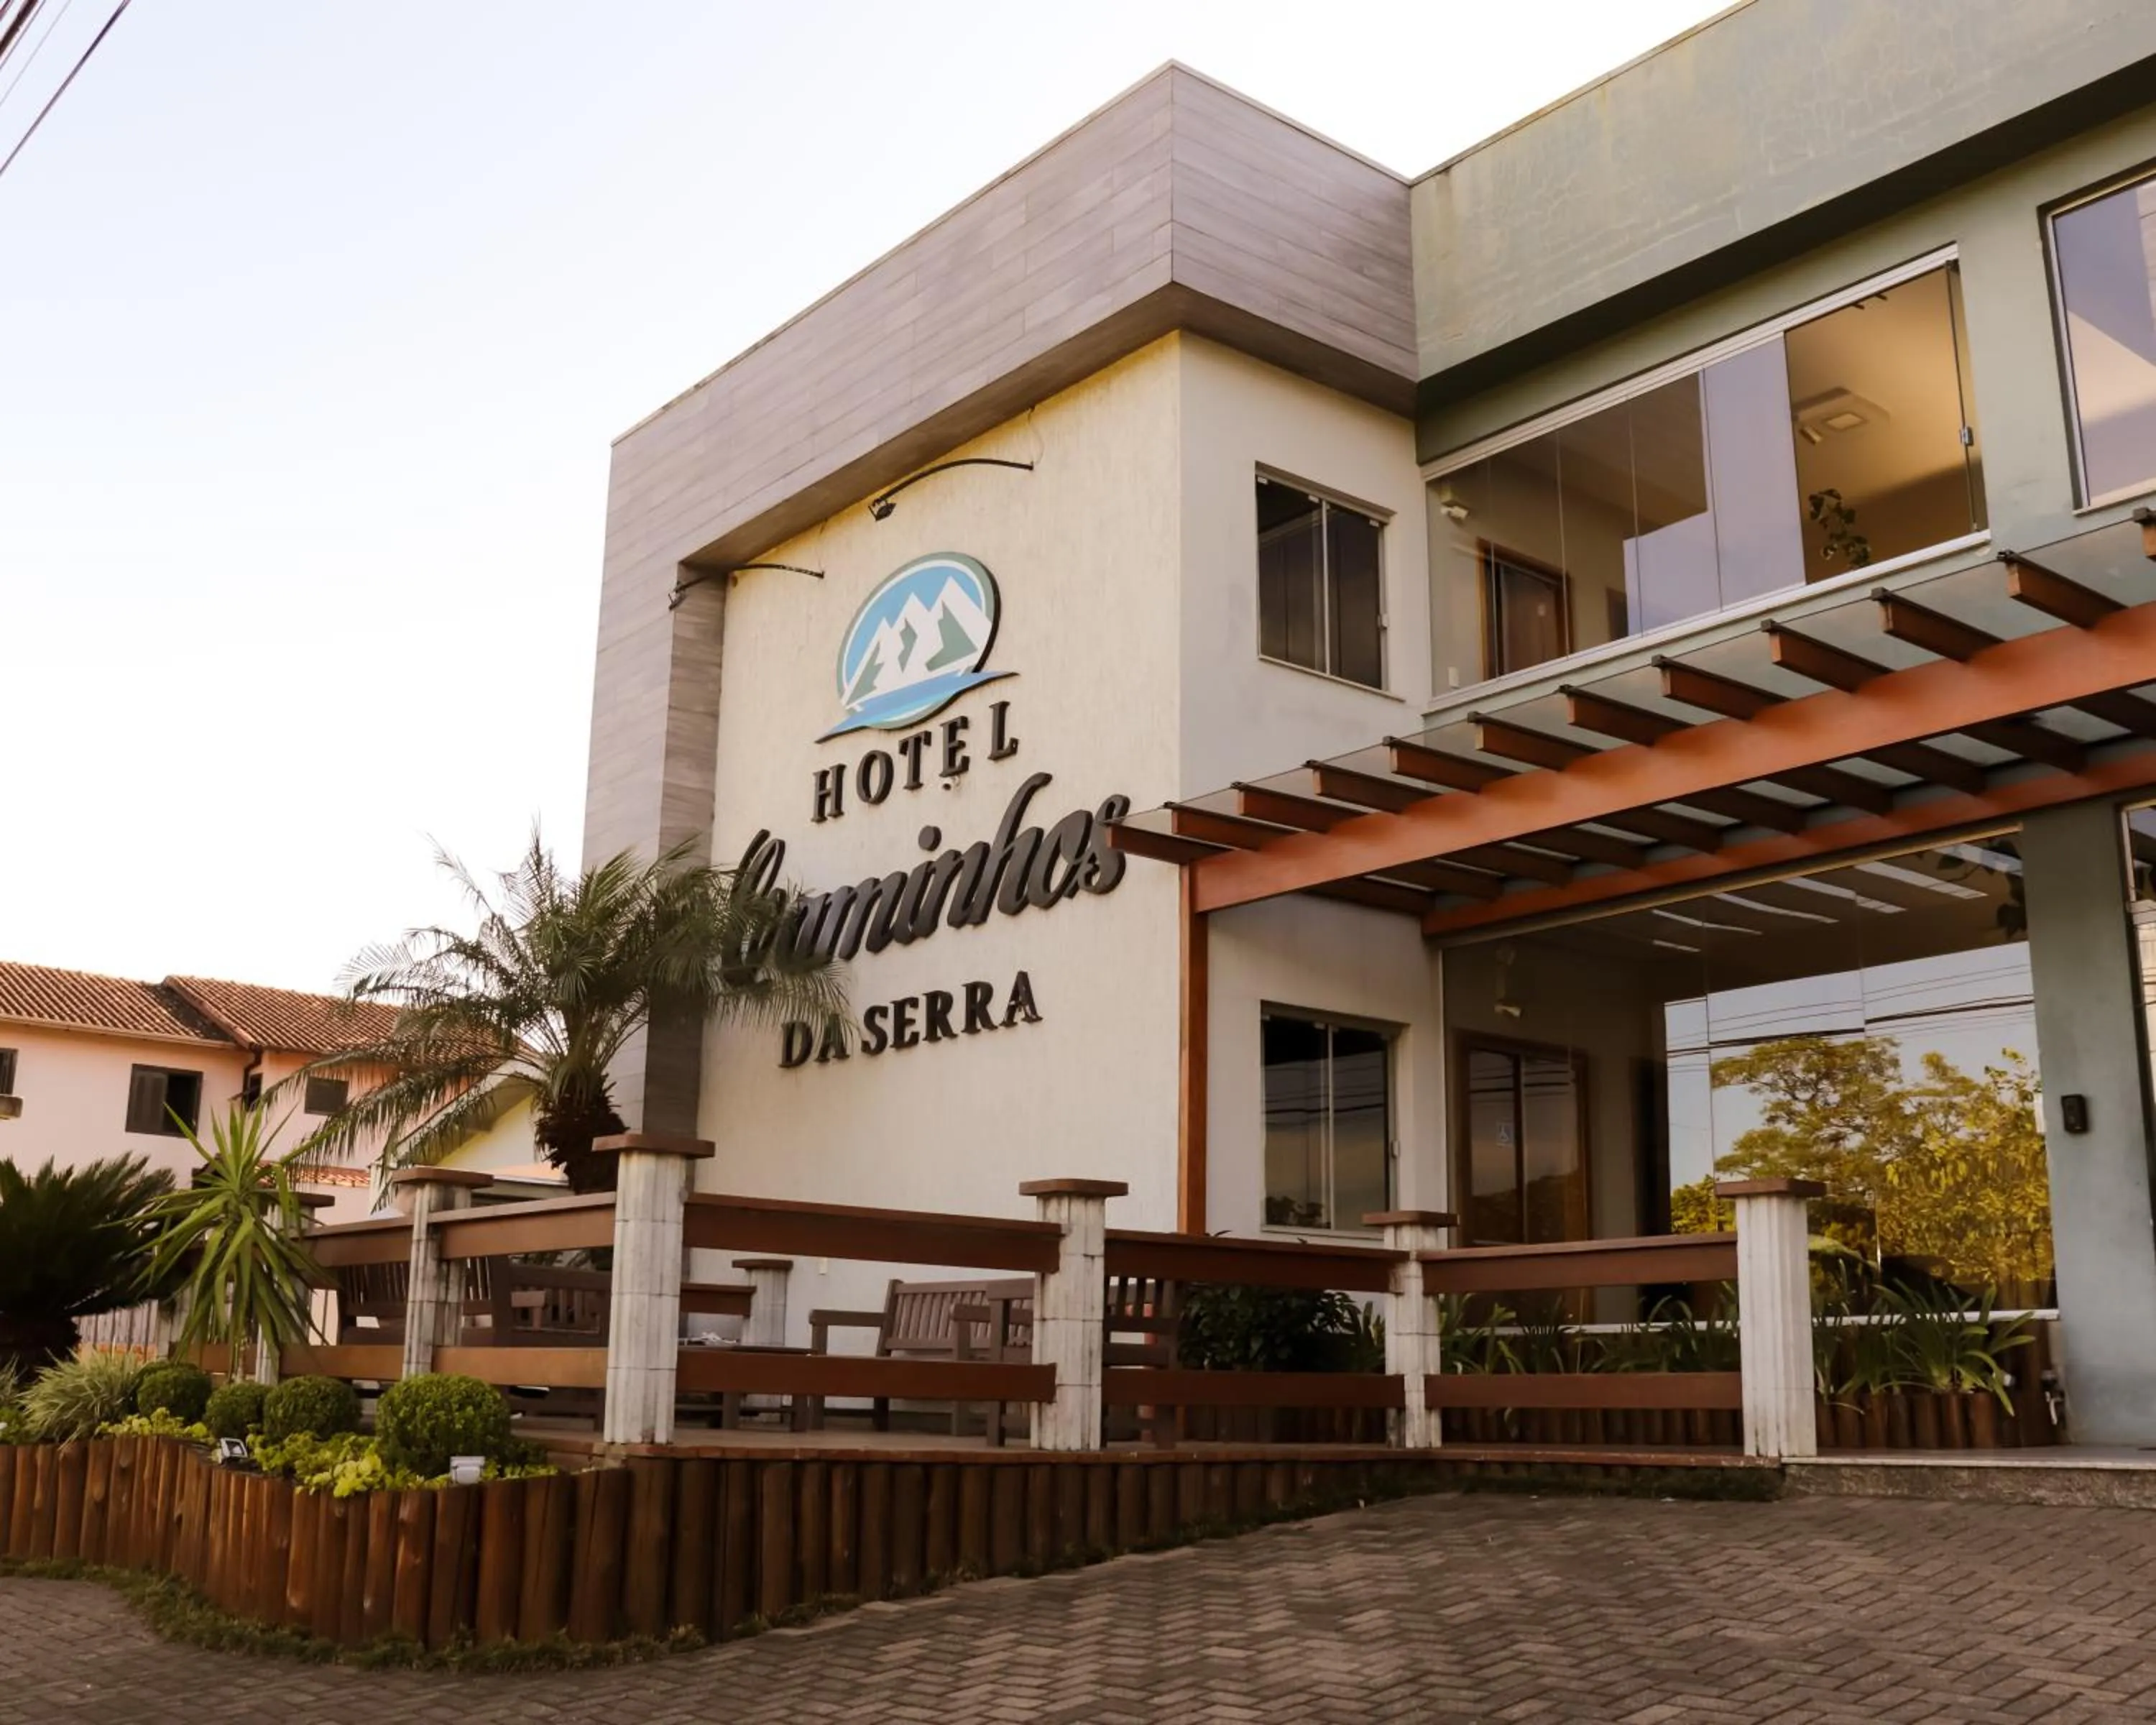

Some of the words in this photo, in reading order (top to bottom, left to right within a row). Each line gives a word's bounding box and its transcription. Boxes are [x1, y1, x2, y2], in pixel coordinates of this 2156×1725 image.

[811, 702, 1018, 822] HOTEL
[780, 1013, 849, 1067] DA
[861, 971, 1043, 1055] SERRA
